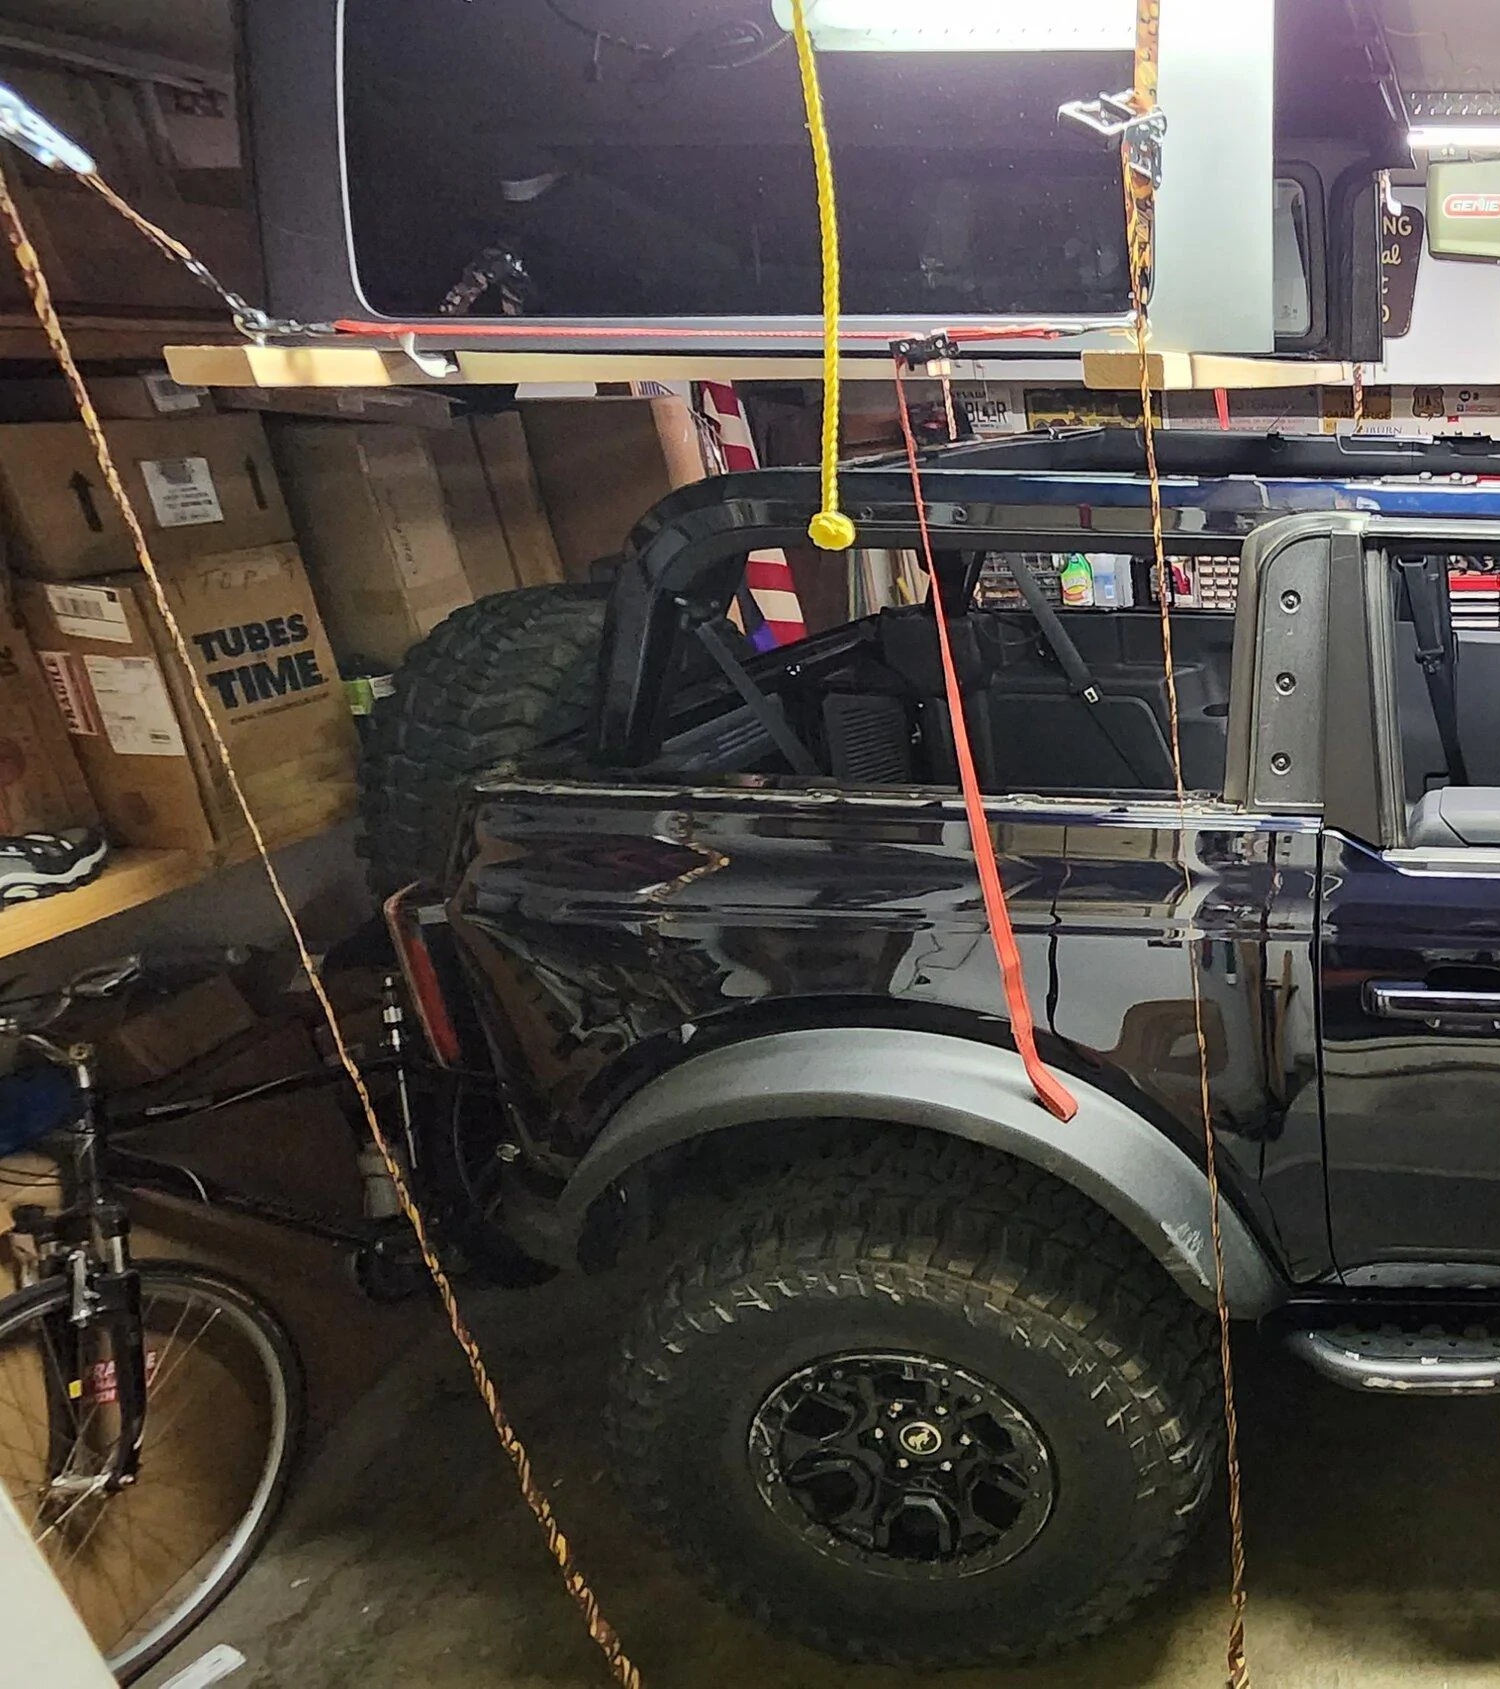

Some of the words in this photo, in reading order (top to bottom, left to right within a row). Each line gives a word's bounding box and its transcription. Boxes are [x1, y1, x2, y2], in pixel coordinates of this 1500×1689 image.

[1451, 196, 1500, 212] GENIE
[1382, 215, 1412, 236] NG
[1381, 243, 1401, 265] al
[191, 613, 310, 664] TUBES
[206, 650, 325, 710] TIME
